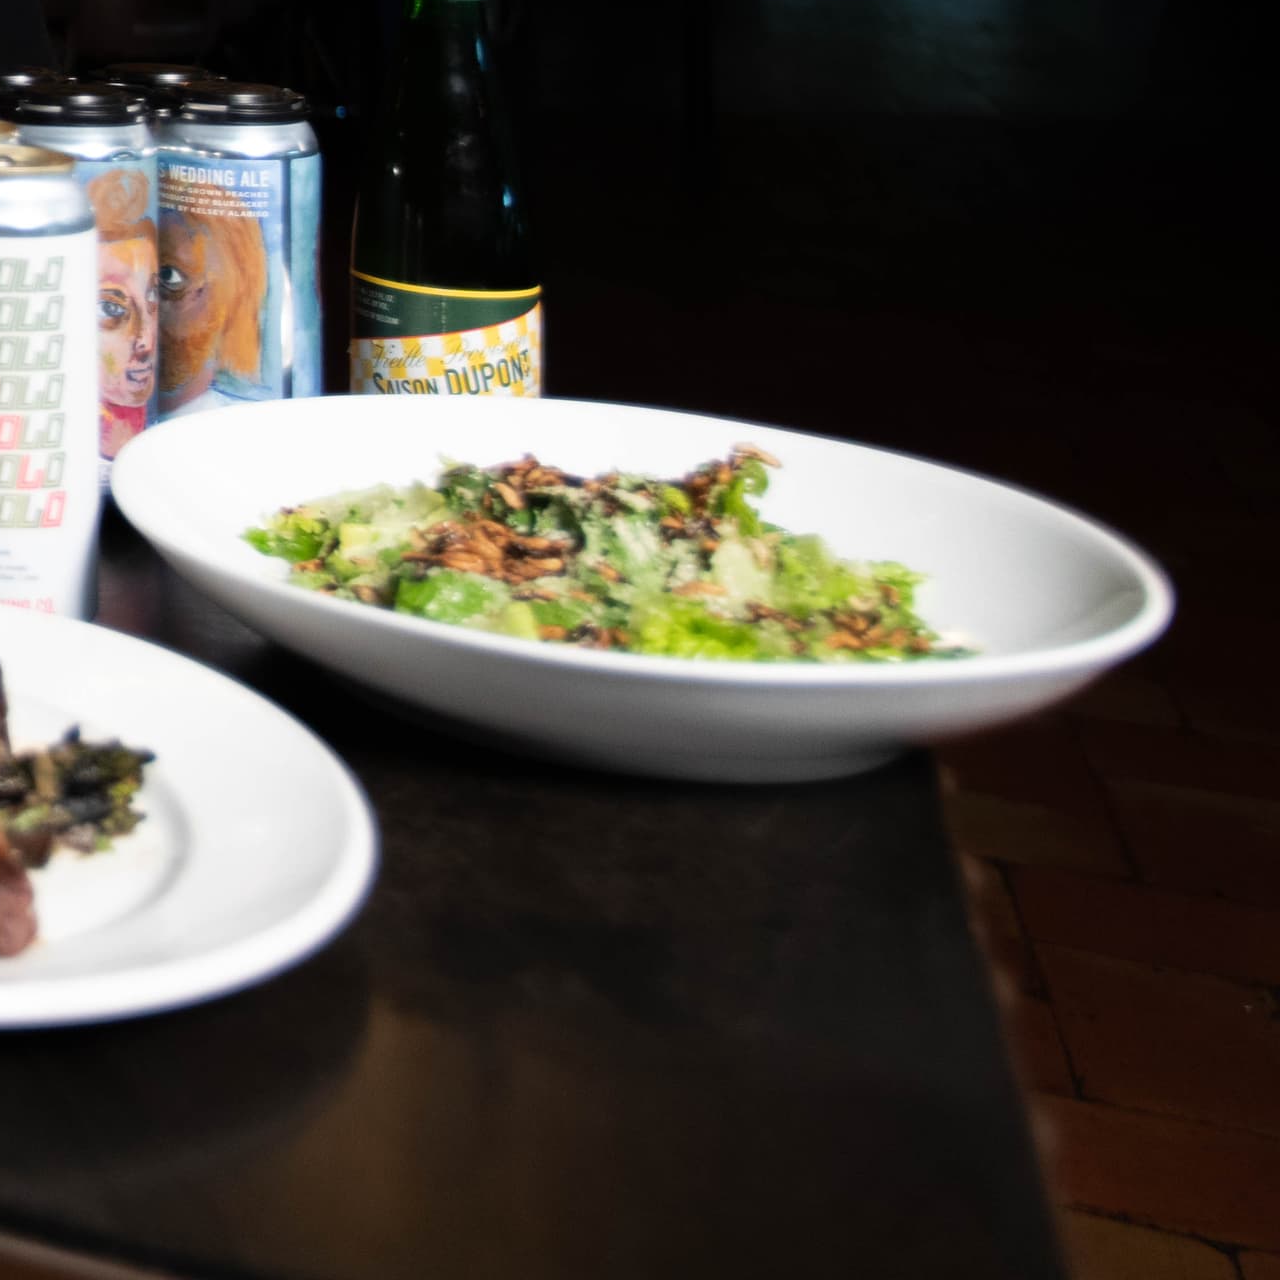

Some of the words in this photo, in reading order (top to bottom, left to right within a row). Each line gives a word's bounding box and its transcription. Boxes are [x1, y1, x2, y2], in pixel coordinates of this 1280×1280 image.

[168, 164, 236, 187] WEDDING
[239, 170, 271, 188] ALE
[212, 198, 270, 208] BLUEJACKET
[443, 348, 530, 395] DUPONT
